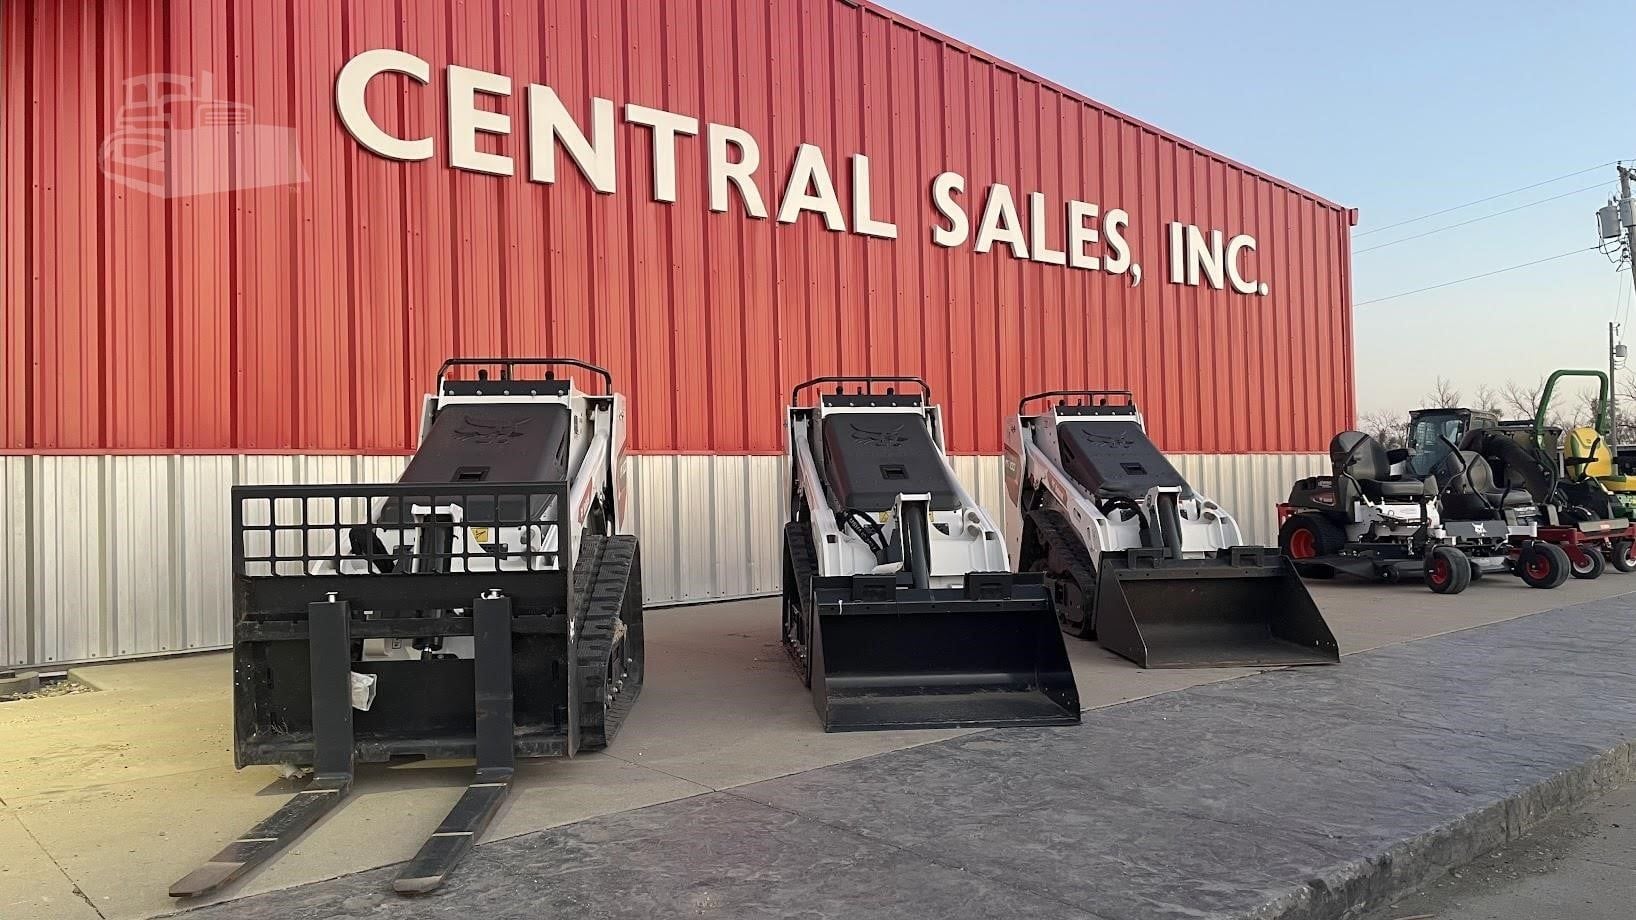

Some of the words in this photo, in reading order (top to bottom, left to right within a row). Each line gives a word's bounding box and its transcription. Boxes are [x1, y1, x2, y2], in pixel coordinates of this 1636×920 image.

[335, 49, 898, 240] CENTRAL
[932, 171, 1142, 287] SALES,
[1169, 221, 1269, 296] INC.
